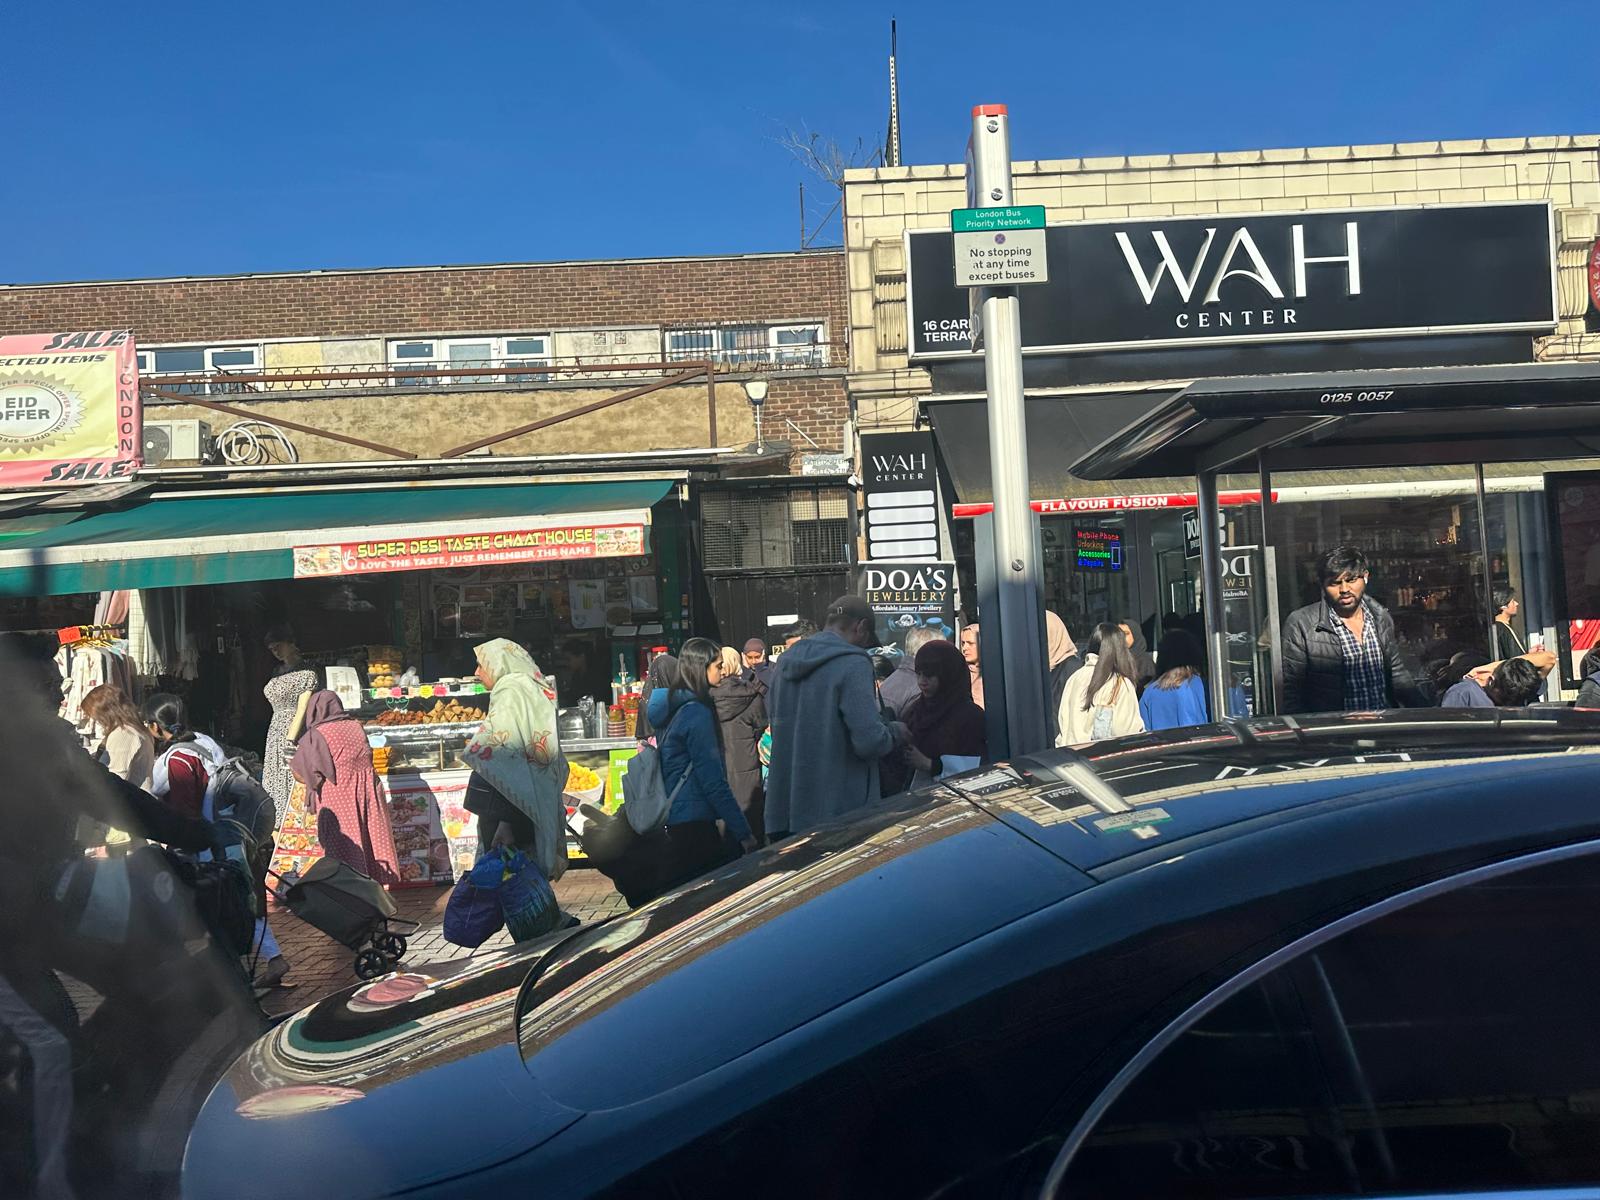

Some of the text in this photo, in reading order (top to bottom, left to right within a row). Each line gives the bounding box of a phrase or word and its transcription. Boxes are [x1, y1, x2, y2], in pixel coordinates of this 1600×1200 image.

[966, 218, 1031, 228] Priority Network
[969, 246, 1032, 257] No stopping
[986, 260, 1004, 269] any
[1007, 259, 1029, 267] time
[1114, 221, 1361, 305] WAH
[969, 270, 1035, 281] except buses
[1176, 309, 1296, 328] CENTER
[922, 318, 970, 331] 16 CAR
[52, 354, 107, 365] ITEMS
[5, 397, 37, 408] EID
[1320, 391, 1394, 403] 0125 0057
[872, 453, 926, 472] WAH
[876, 473, 924, 481] CENTER
[1041, 497, 1168, 511] FLAVOUR FUSION
[357, 528, 593, 558] SUPER DESI TASTE CHAAT HOUSE
[361, 560, 387, 570] LOVE
[391, 559, 410, 567] THE
[450, 554, 475, 565] JUST
[477, 550, 535, 561] REMEMBER
[537, 548, 557, 557] THE
[560, 546, 591, 556] NAME
[1078, 549, 1111, 558] Accessories
[866, 567, 946, 591] DOA'S
[866, 592, 946, 603] JEWELLERY
